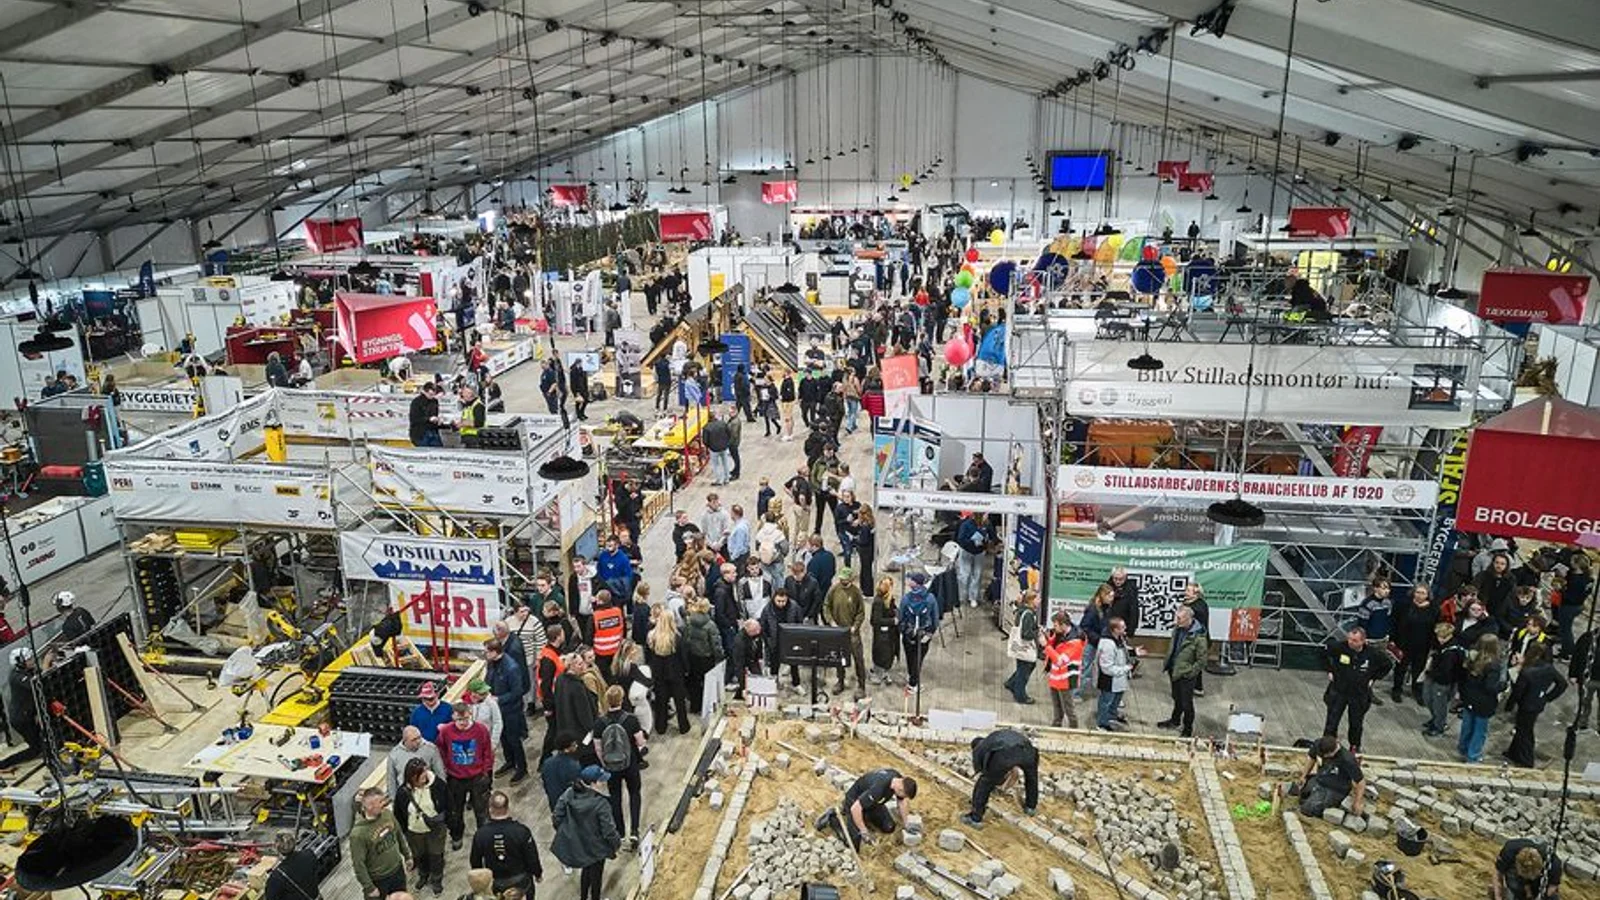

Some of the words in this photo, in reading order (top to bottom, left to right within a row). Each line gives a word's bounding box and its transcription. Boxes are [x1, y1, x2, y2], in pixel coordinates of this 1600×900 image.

[1485, 307, 1548, 319] TÆKKEMAND
[1137, 368, 1178, 382] Bliv
[1183, 367, 1349, 389] Stilladsmontør
[1104, 474, 1239, 493] STILLADSARBEJDERNES
[1243, 481, 1328, 497] BRANCHEKLUB
[1332, 485, 1348, 498] AF
[1353, 486, 1384, 500] 1920
[382, 543, 483, 562] BYSTILLADS
[1130, 547, 1146, 556] at
[1147, 548, 1187, 558] skabe
[1128, 558, 1201, 569] fremtidens
[1203, 560, 1263, 571] Danmark
[411, 594, 488, 628] PERI
